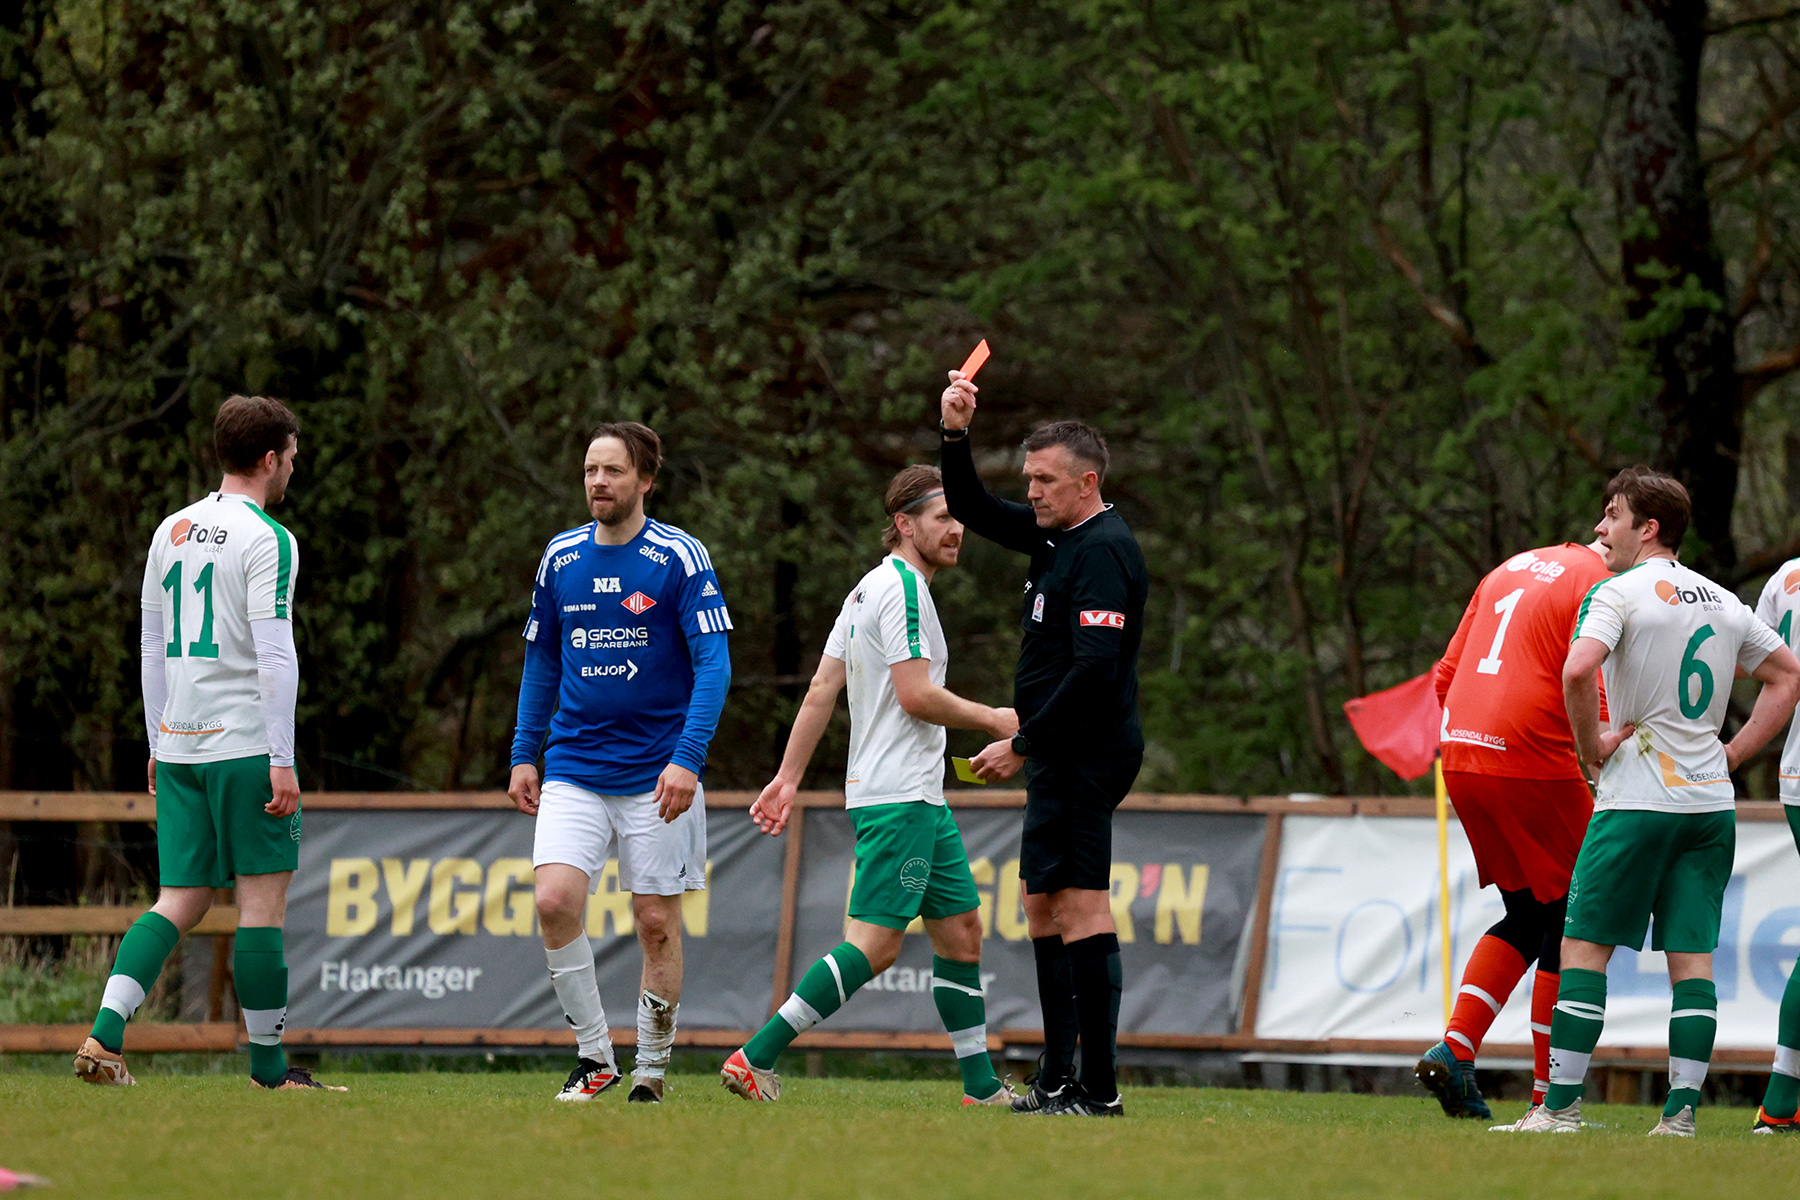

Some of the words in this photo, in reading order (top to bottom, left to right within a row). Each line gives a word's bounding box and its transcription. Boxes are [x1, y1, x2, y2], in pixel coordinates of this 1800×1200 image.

[186, 523, 228, 545] folla
[592, 577, 622, 593] NA
[1674, 585, 1723, 605] folla
[161, 560, 219, 659] 11
[580, 603, 597, 612] 1000
[1083, 612, 1126, 628] VG
[588, 626, 648, 641] GRONG
[1476, 588, 1525, 675] 1
[589, 639, 649, 649] SPAREBANK
[1678, 623, 1716, 720] 6
[197, 719, 222, 730] BYGG
[1450, 728, 1483, 741] ROSENDAL
[1483, 733, 1506, 746] BYGG
[320, 961, 483, 999] Flatanger
